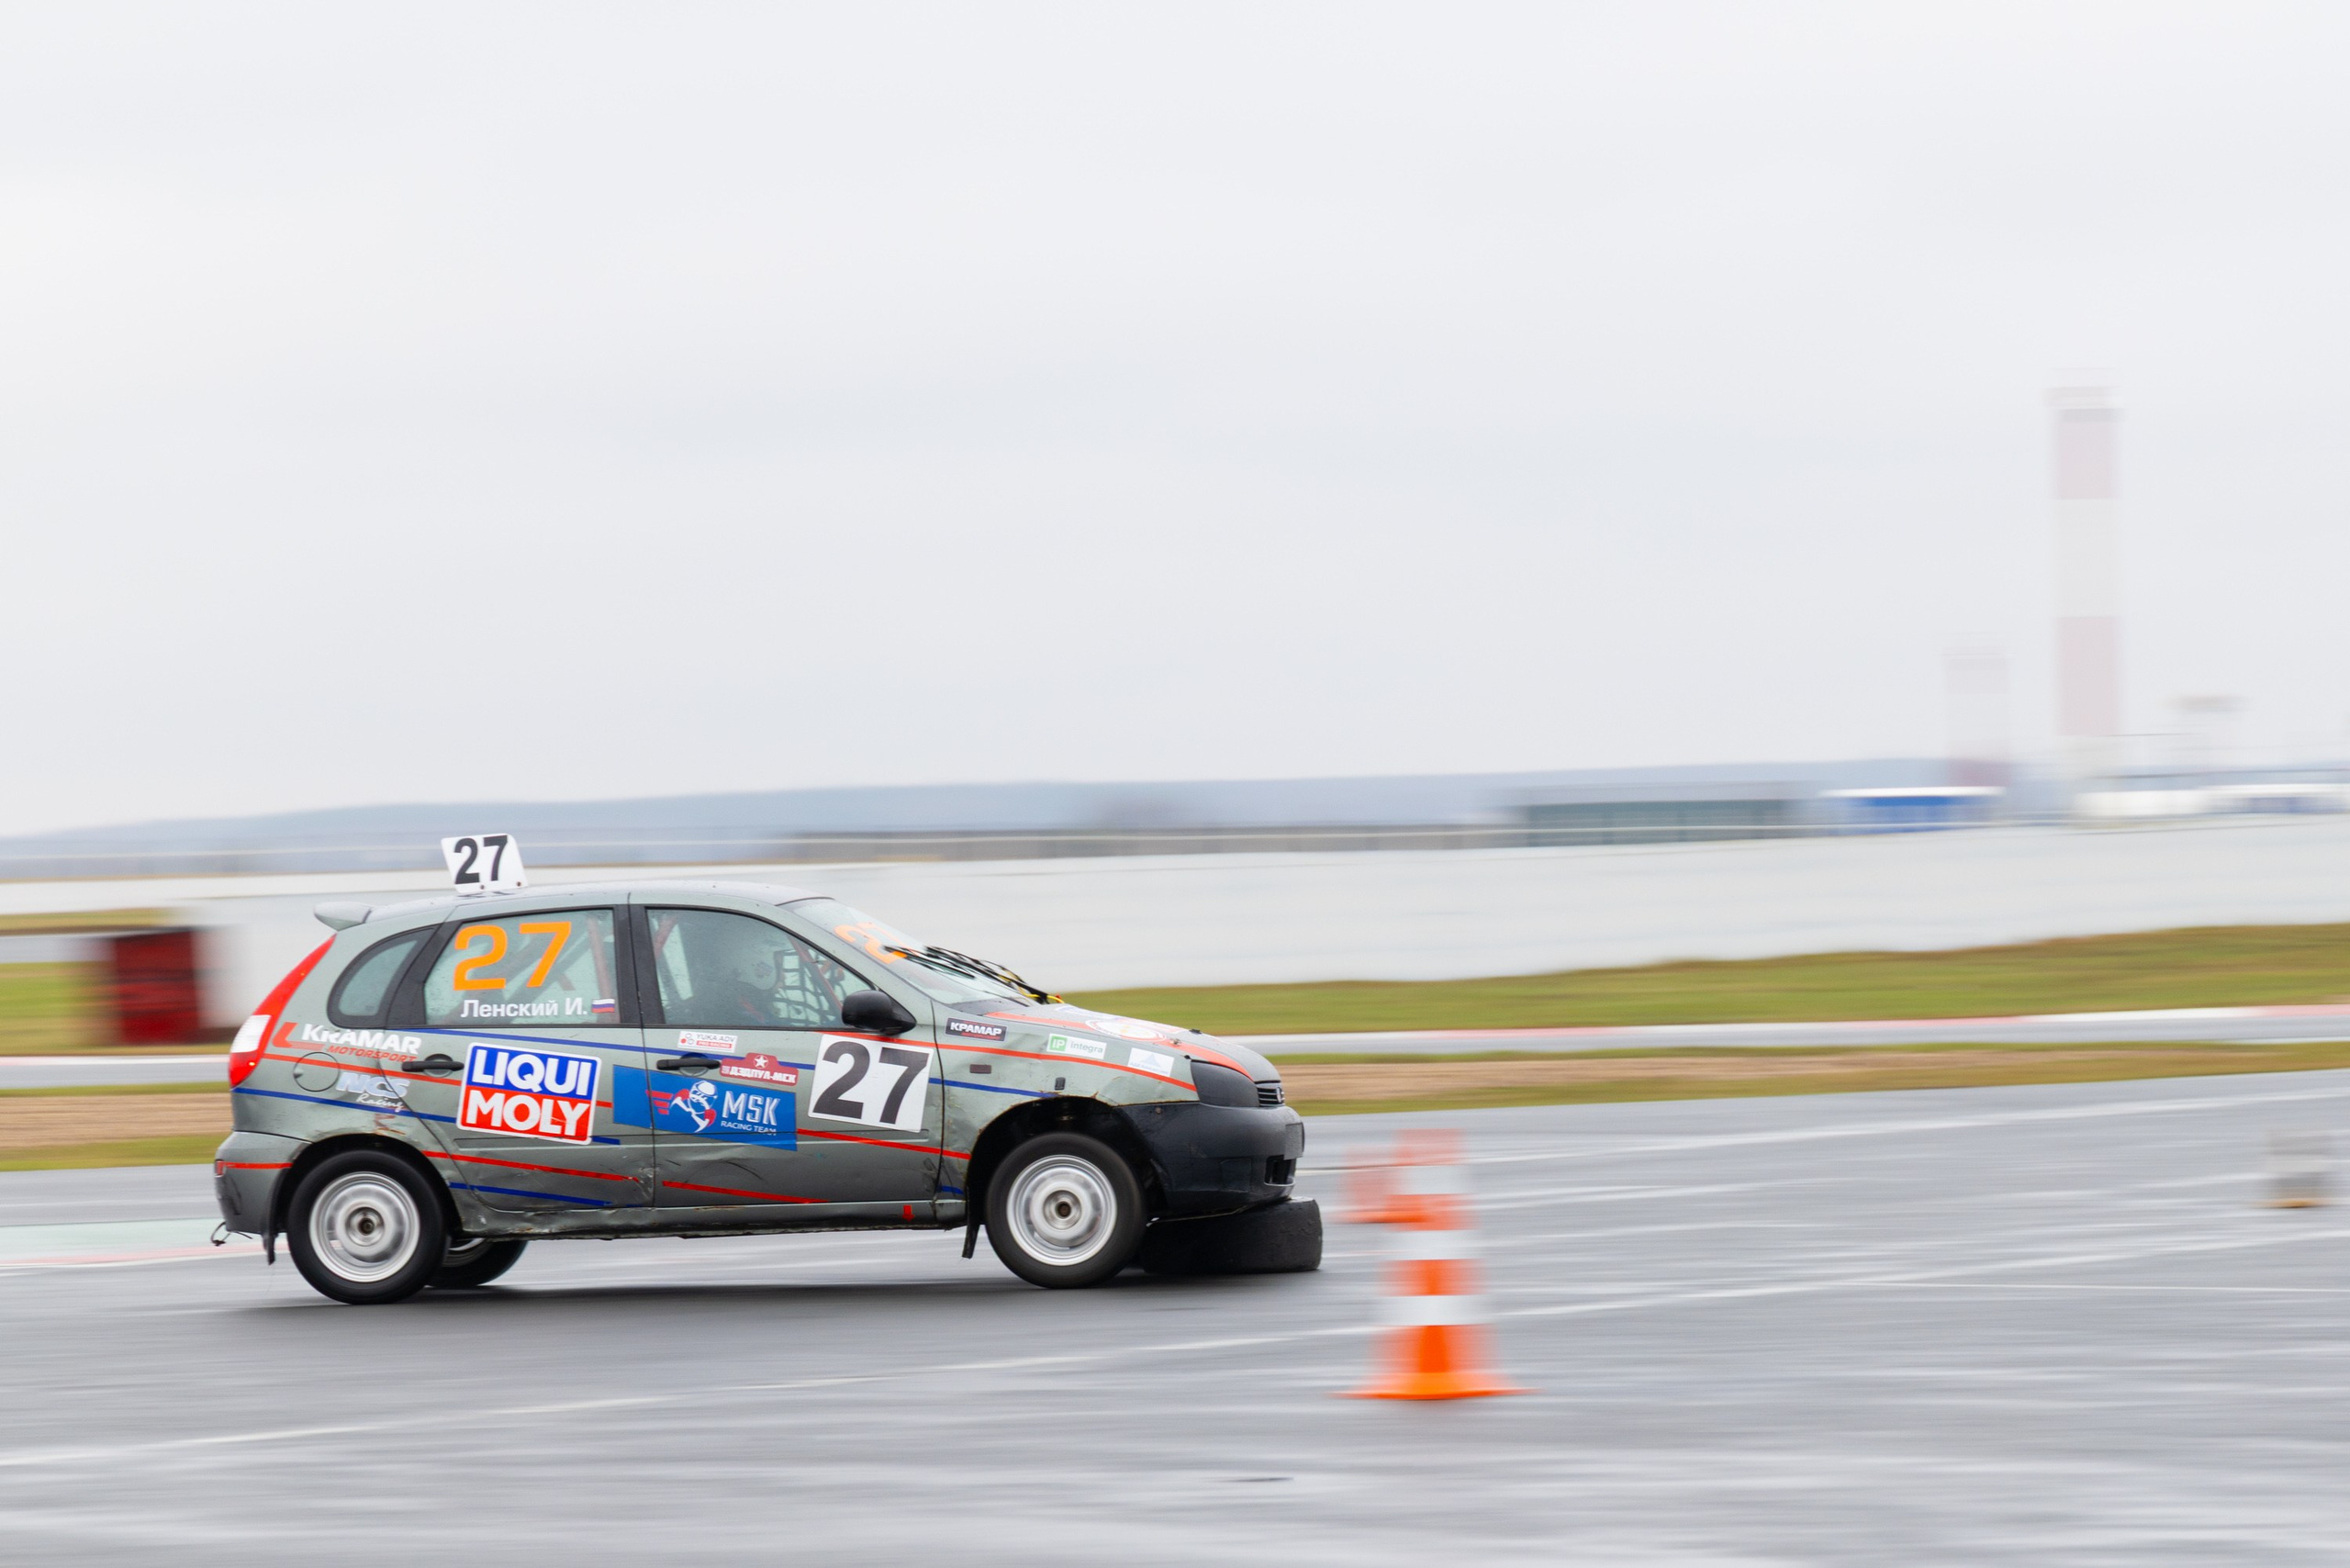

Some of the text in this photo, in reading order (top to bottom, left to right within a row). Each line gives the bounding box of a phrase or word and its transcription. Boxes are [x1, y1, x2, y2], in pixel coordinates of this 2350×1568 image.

[454, 834, 508, 885] 27
[453, 922, 571, 991] 27
[460, 997, 588, 1017] Ленский И.
[327, 1046, 418, 1063] MOTORSPORT
[1051, 1038, 1103, 1054] IP integra
[471, 1048, 591, 1096] LIQUI
[812, 1041, 927, 1126] 27
[466, 1091, 590, 1137] MOLY
[721, 1120, 777, 1137] RACING TEAM
[722, 1091, 781, 1126] MSK
